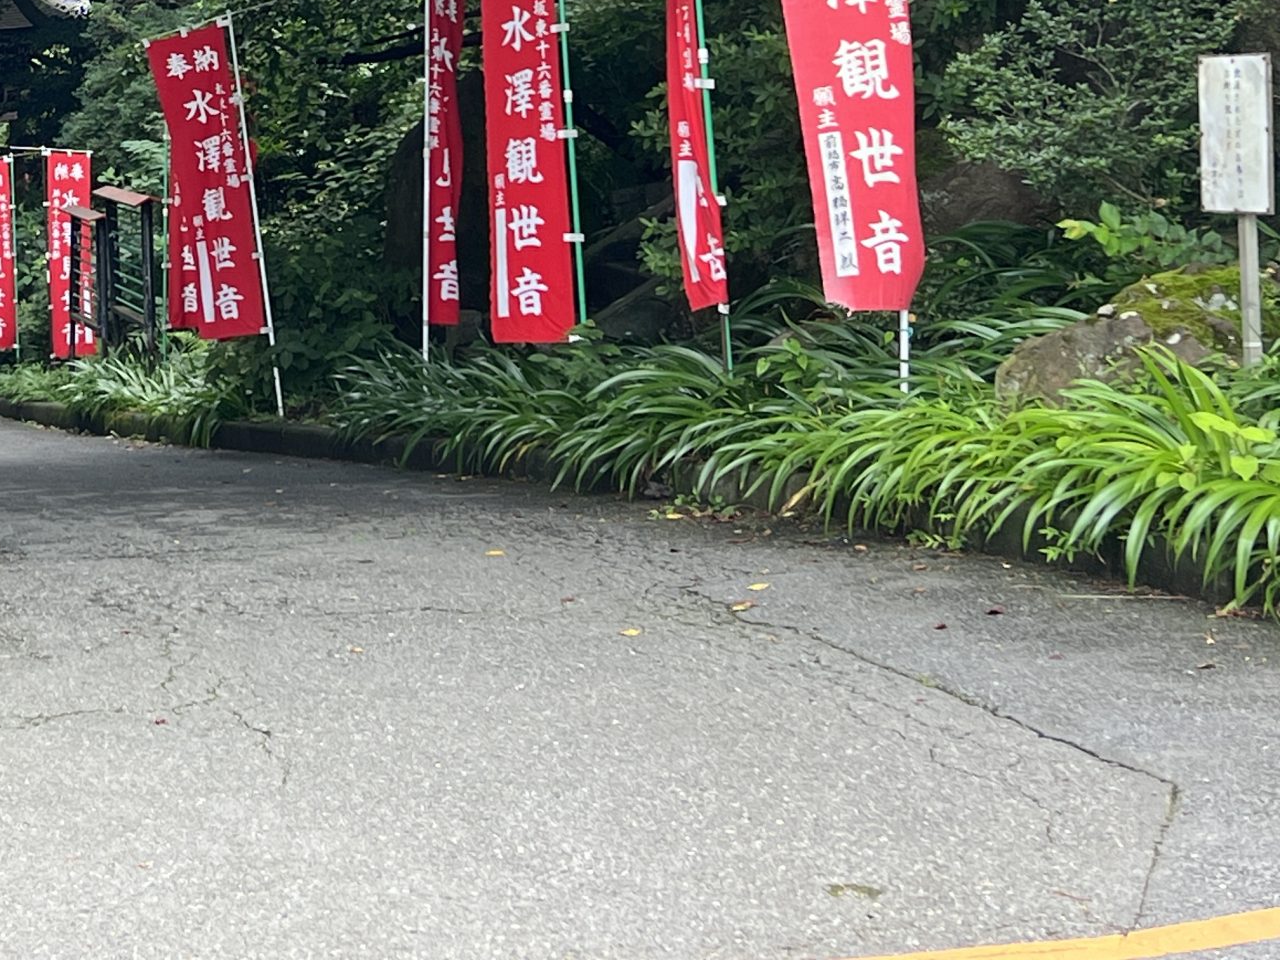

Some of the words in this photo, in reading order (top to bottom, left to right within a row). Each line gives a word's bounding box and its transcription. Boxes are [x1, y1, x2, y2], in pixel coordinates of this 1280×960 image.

[166, 45, 220, 80] 奉納
[533, 0, 557, 142] 坂東十六番霊場
[812, 86, 839, 129] 願主
[183, 89, 245, 320] 水澤観世音
[501, 6, 549, 317] 水澤観世音
